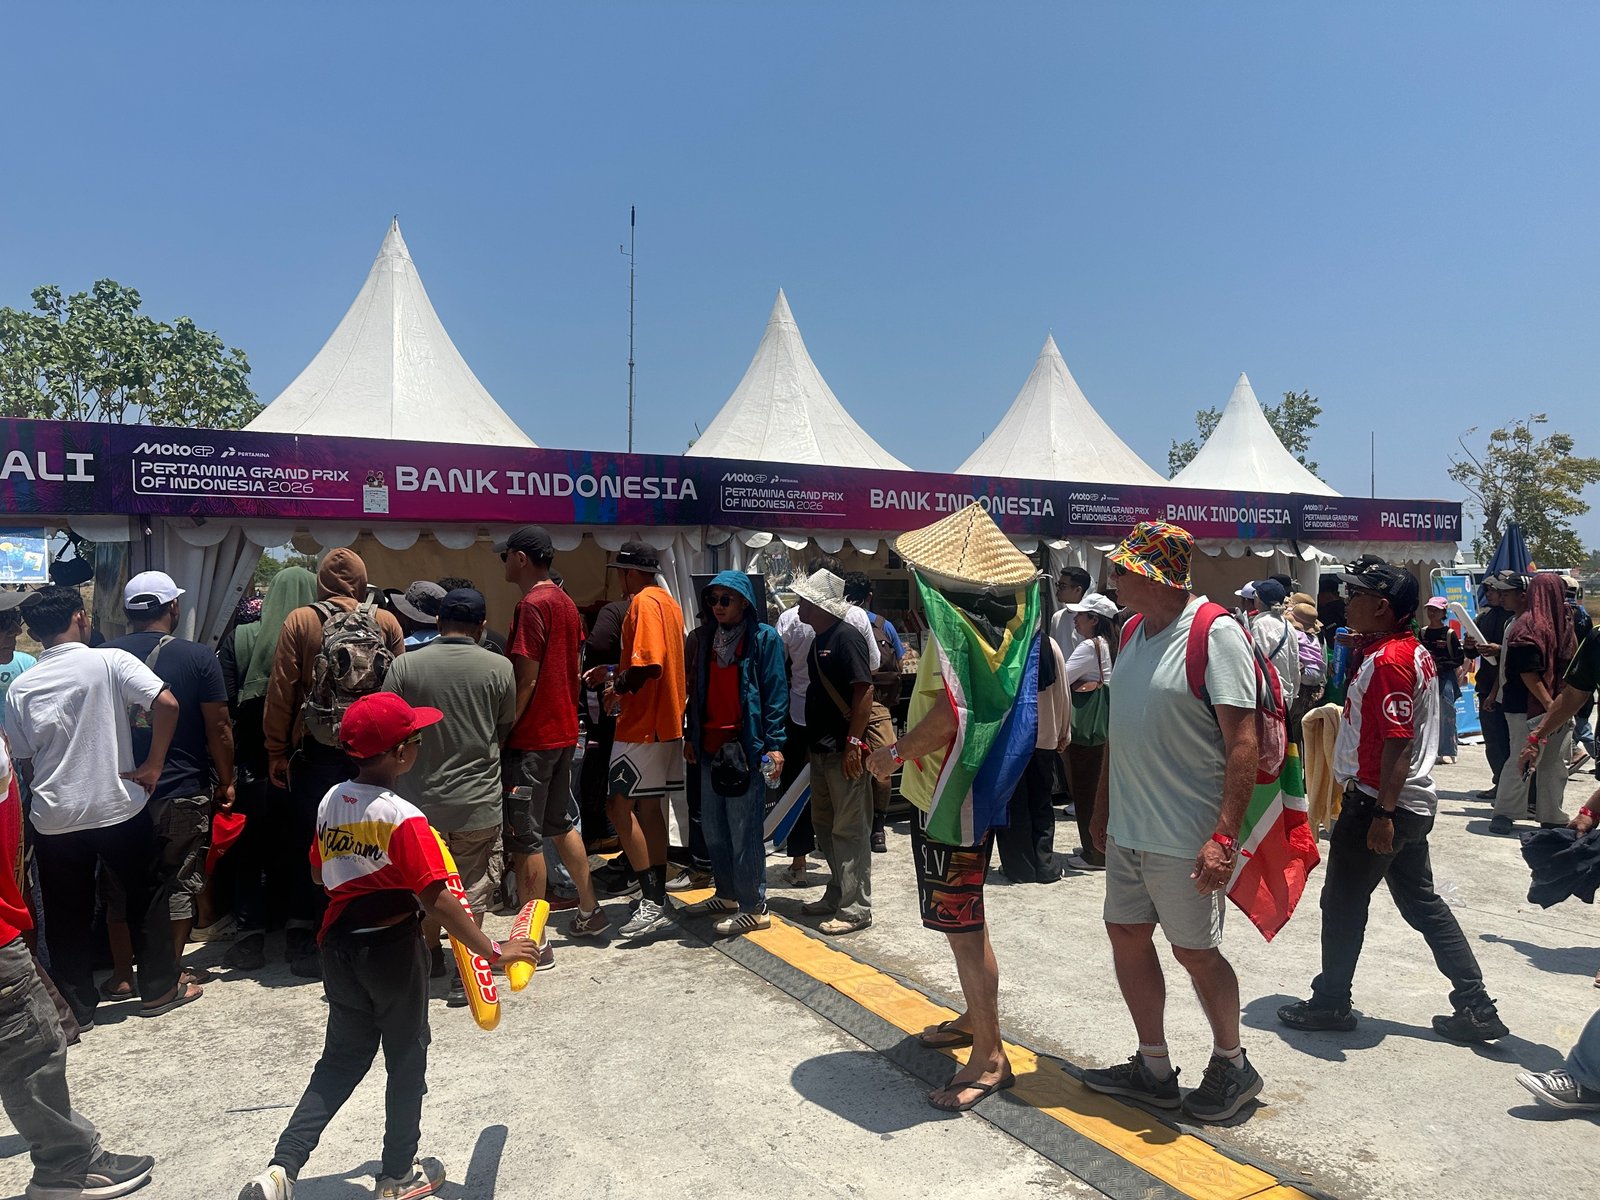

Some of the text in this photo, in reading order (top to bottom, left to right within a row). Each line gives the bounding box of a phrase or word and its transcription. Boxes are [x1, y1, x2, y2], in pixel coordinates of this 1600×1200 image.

[132, 442, 215, 457] MotoGP
[0, 450, 95, 482] ALI
[140, 462, 350, 482] PERTAMINA GRAND PRIX
[140, 476, 314, 494] OF INDONESIA 2026
[395, 465, 698, 500] BANK INDONESIA
[721, 472, 767, 484] MotoGP
[725, 487, 844, 501] PERTAMINA GRAND PRIX
[870, 488, 931, 511] BANK
[725, 498, 824, 510] OF INDONESIA 2026
[1071, 504, 1150, 515] PERTAMINA GRAND PRIX
[1082, 513, 1118, 522] INDONESIA
[1118, 514, 1136, 523] 2026
[1166, 504, 1291, 524] BANK INDONESIA
[1380, 512, 1458, 529] PALETAS WEY
[1386, 700, 1411, 717] 45
[469, 948, 499, 1003] OSS
